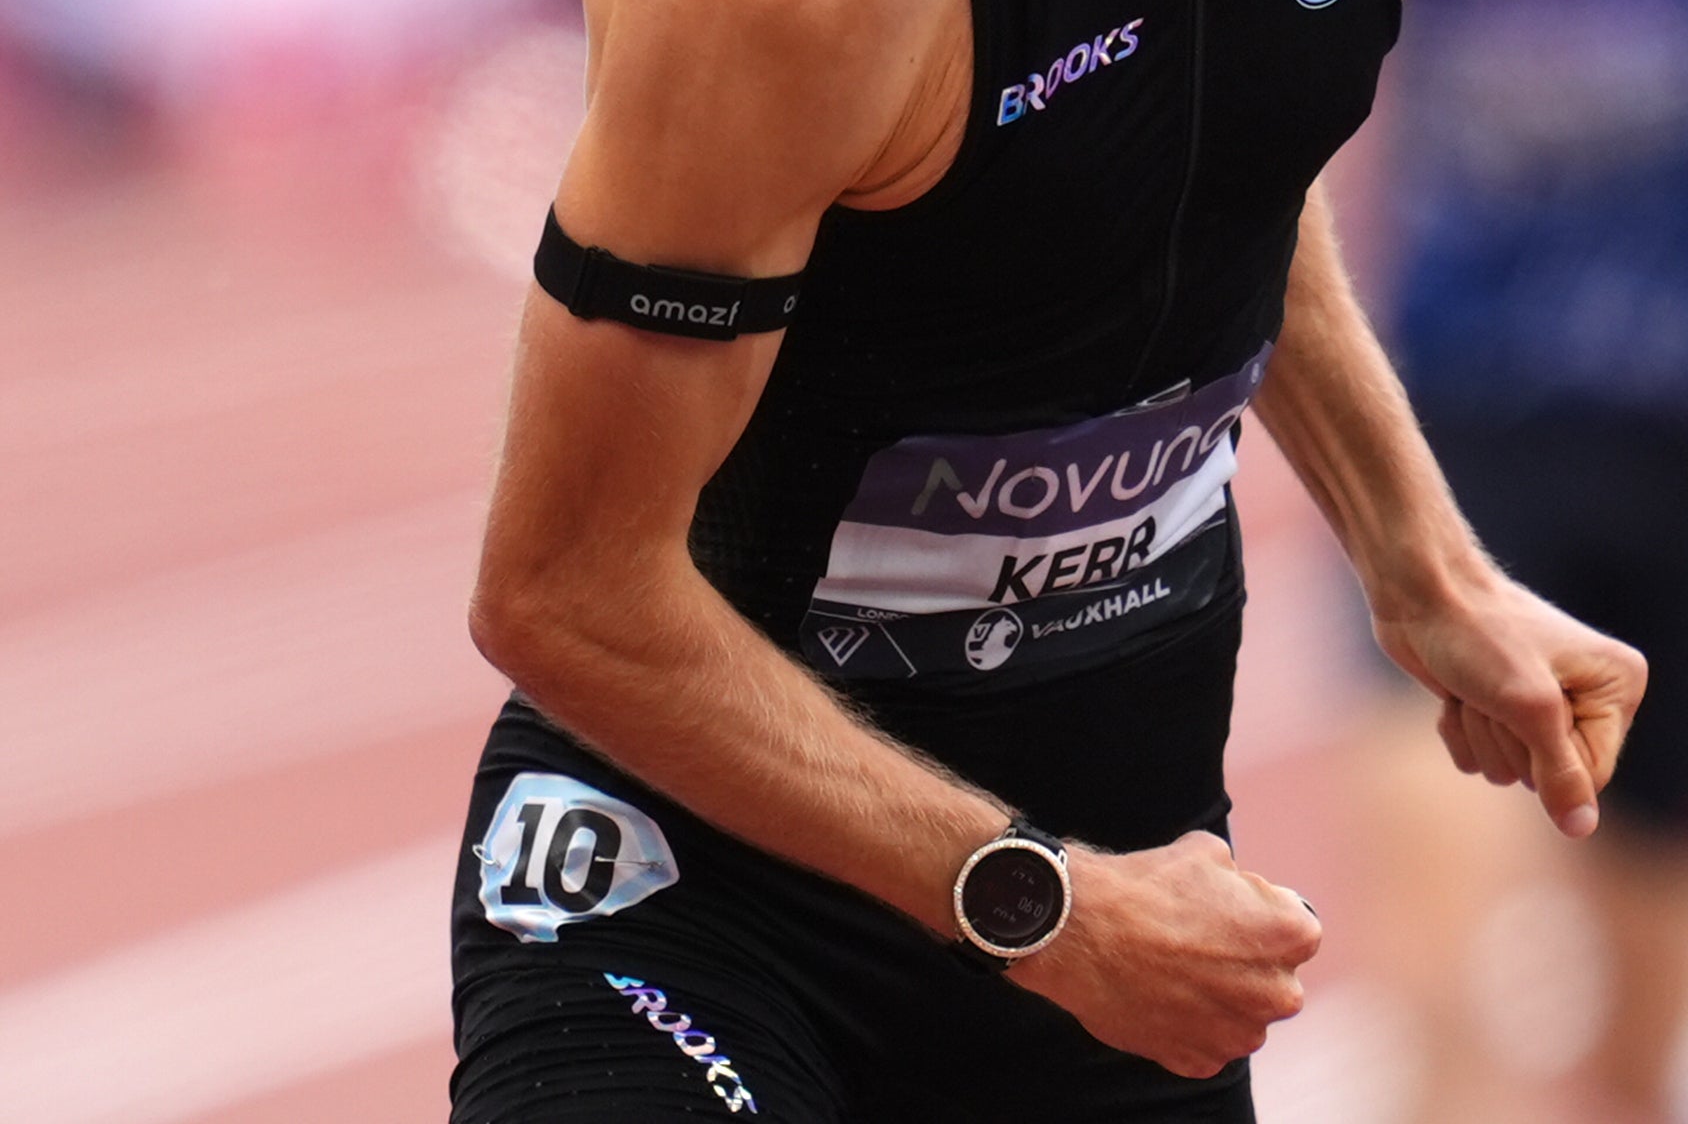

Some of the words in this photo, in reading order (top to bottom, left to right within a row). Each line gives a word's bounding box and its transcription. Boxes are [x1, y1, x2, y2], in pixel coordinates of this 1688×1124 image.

[996, 17, 1145, 126] BROOKS
[988, 515, 1157, 604] KERR
[1030, 577, 1171, 640] VAUXHALL
[500, 802, 622, 914] 10
